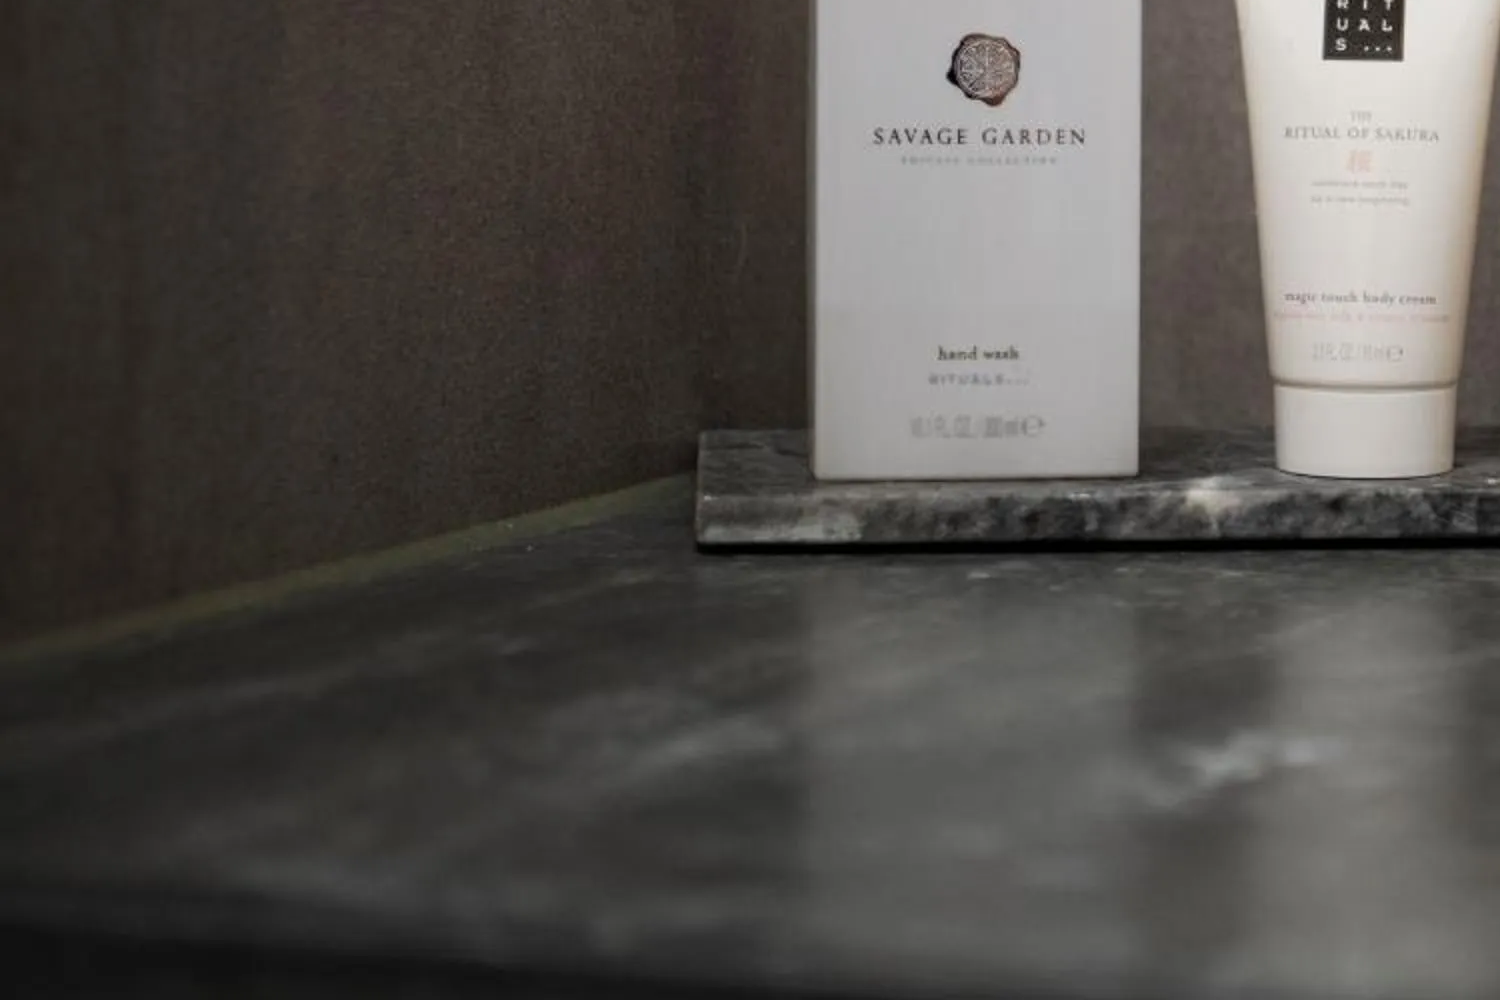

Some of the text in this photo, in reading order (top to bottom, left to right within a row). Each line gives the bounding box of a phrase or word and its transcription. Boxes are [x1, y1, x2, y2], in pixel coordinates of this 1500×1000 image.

[872, 127, 1087, 145] SAVAGE GARDEN
[1283, 125, 1440, 142] RITUAL OF SAKURA
[1363, 288, 1397, 306] body
[1399, 293, 1437, 305] cream
[936, 345, 1020, 360] hand wash
